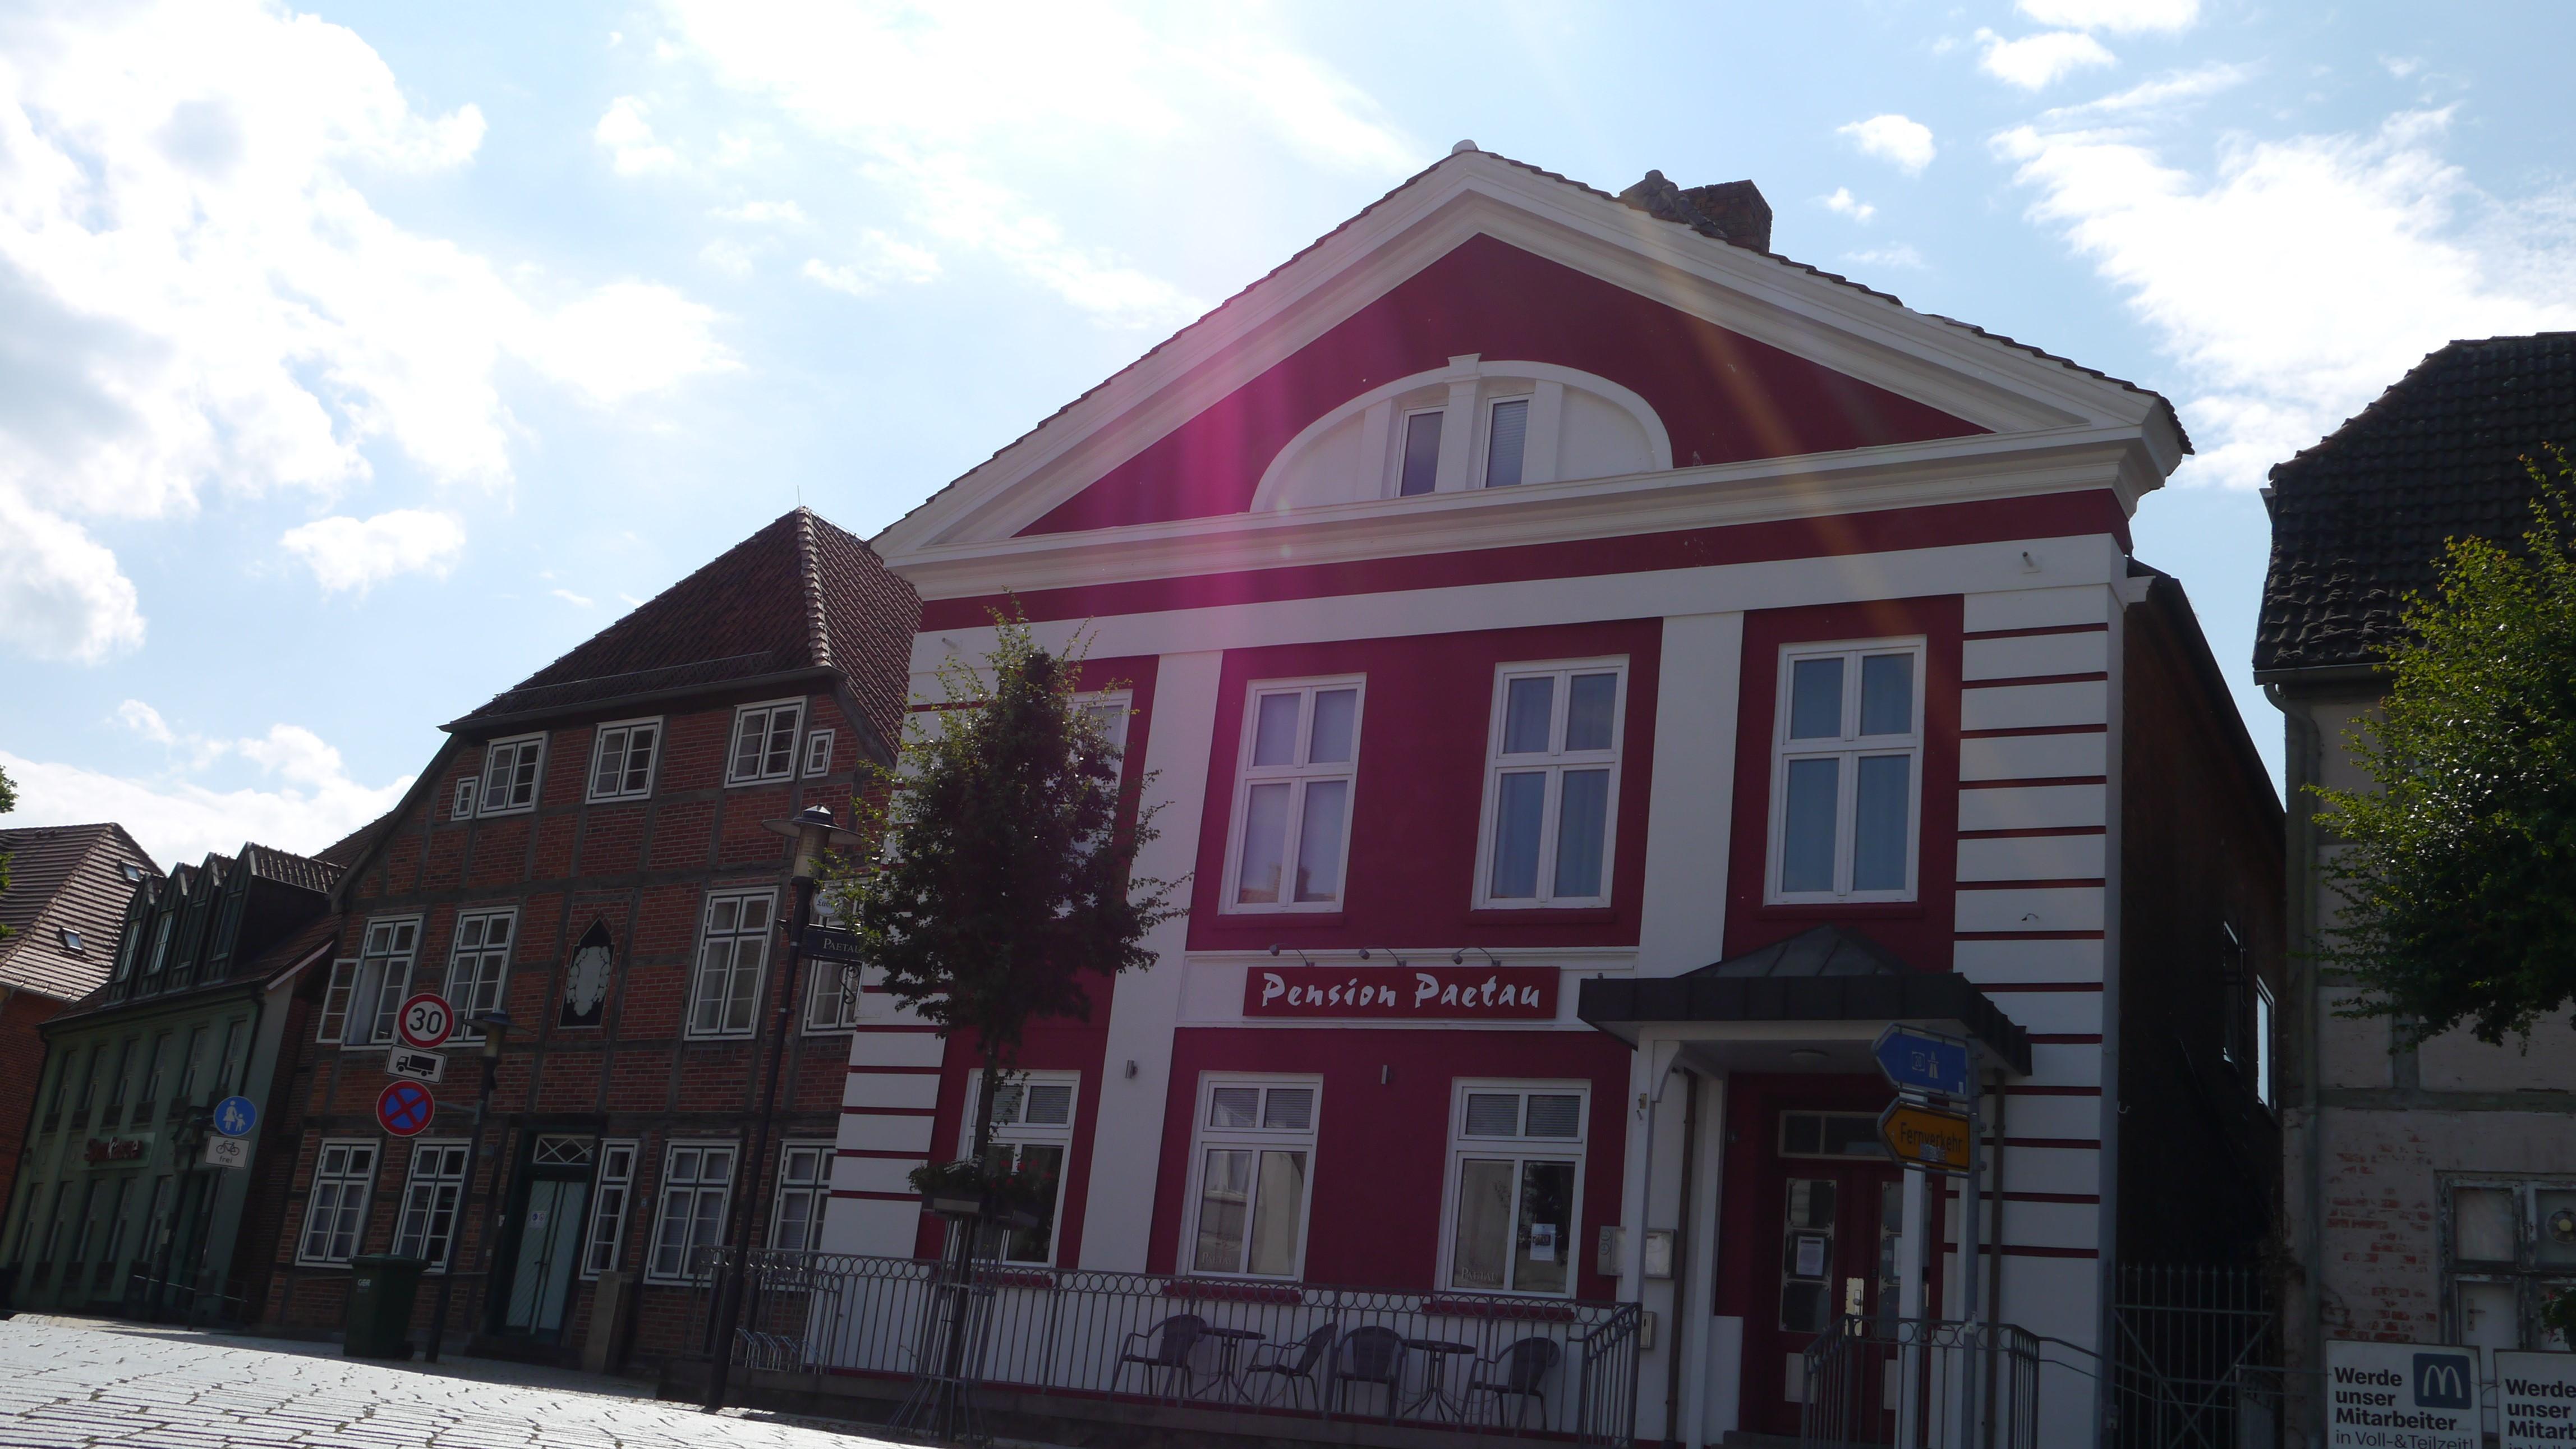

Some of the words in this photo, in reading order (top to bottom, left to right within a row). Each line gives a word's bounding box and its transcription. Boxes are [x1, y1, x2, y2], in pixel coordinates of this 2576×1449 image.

[1262, 972, 1396, 1008] Pension
[1415, 972, 1540, 1008] Paetau
[409, 1007, 443, 1034] 30
[1900, 1121, 1963, 1153] Fernverkehr
[2334, 1367, 2403, 1387] Werde
[2335, 1390, 2396, 1406] unser
[2505, 1378, 2576, 1399] Werde
[2335, 1407, 2457, 1431] Mitarbeiter
[2507, 1403, 2572, 1419] unser
[2336, 1429, 2351, 1445] in
